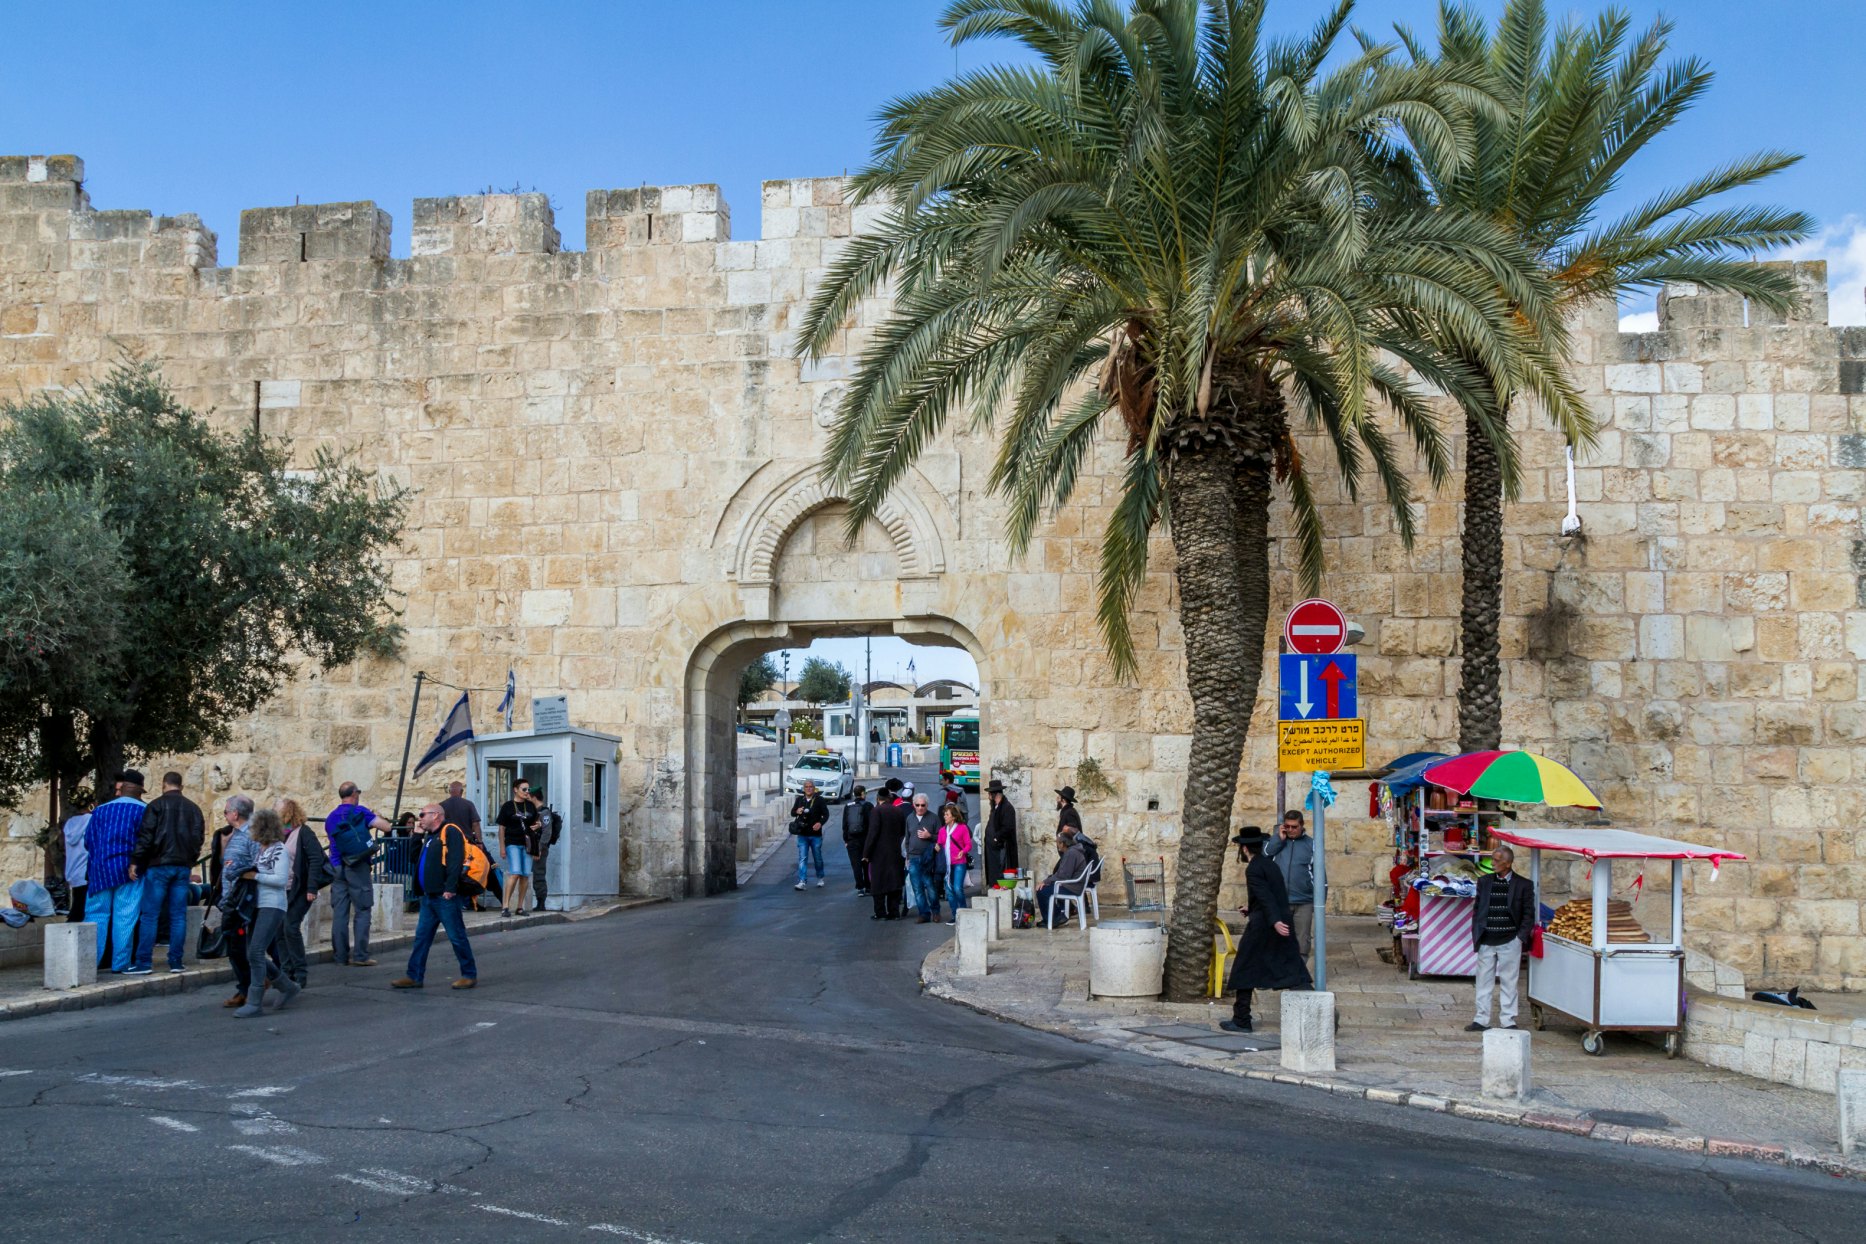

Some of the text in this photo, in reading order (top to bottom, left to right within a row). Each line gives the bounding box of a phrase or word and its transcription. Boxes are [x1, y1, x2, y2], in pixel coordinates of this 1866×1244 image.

[1283, 727, 1310, 735] מורשה
[1313, 726, 1338, 734] לרכב
[1313, 747, 1361, 755] AUTHORIZED
[1305, 757, 1337, 765] VEHICLE
